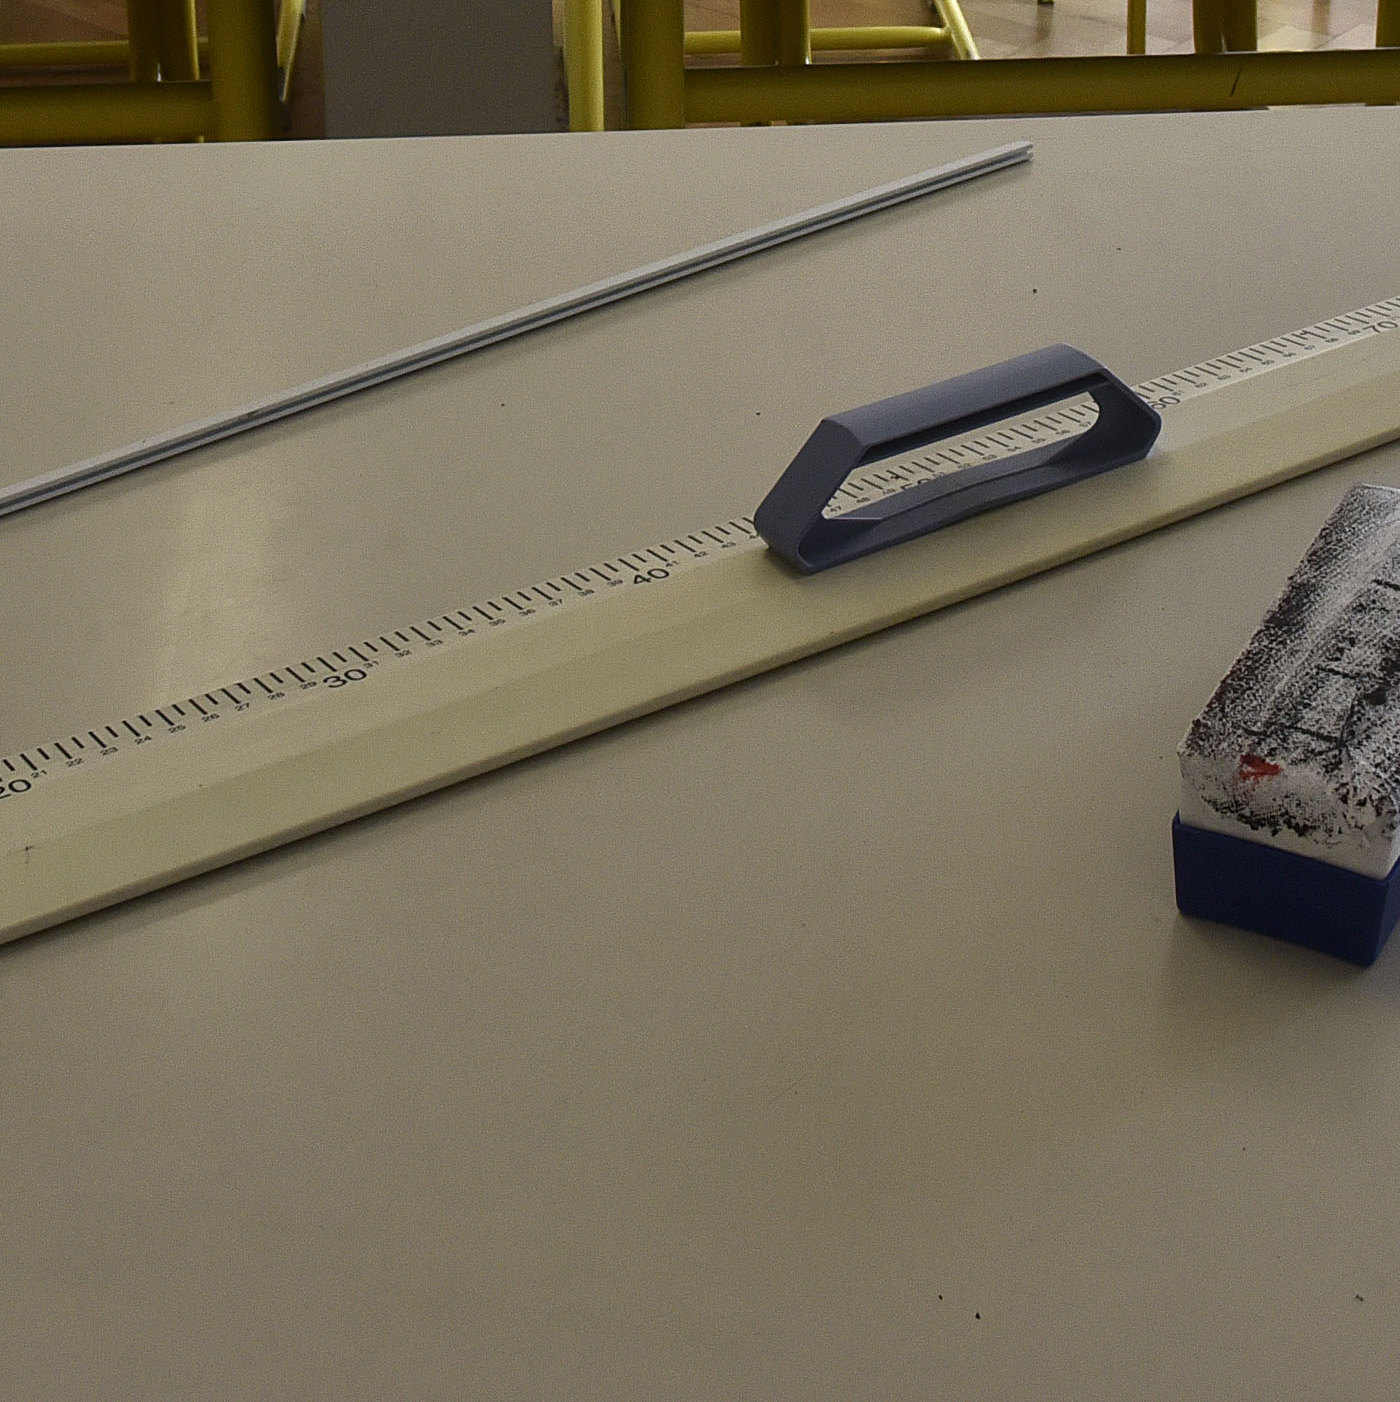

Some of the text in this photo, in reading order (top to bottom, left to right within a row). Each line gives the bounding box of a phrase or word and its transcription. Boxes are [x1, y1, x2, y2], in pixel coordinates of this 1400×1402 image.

[31, 769, 48, 779] 21
[65, 758, 85, 767] 22
[100, 746, 119, 756] 23
[134, 736, 152, 745] 24
[167, 724, 186, 734] 25
[201, 713, 220, 723] 26
[234, 702, 251, 711] 27
[267, 692, 285, 700] 28
[300, 681, 317, 690] 29
[322, 668, 367, 688] 30
[363, 660, 380, 668] 31
[394, 649, 412, 658] 32
[425, 639, 443, 647] 33
[457, 628, 476, 637] 34
[488, 618, 506, 626] 35
[519, 608, 536, 616] 36
[548, 598, 564, 607] 37
[577, 589, 595, 597] 38
[607, 579, 623, 587] 39
[633, 568, 670, 585] 40
[665, 560, 680, 568] 41
[693, 550, 710, 558] 42
[720, 541, 737, 549] 43
[1150, 396, 1181, 410] 60
[1363, 320, 1398, 333] 70
